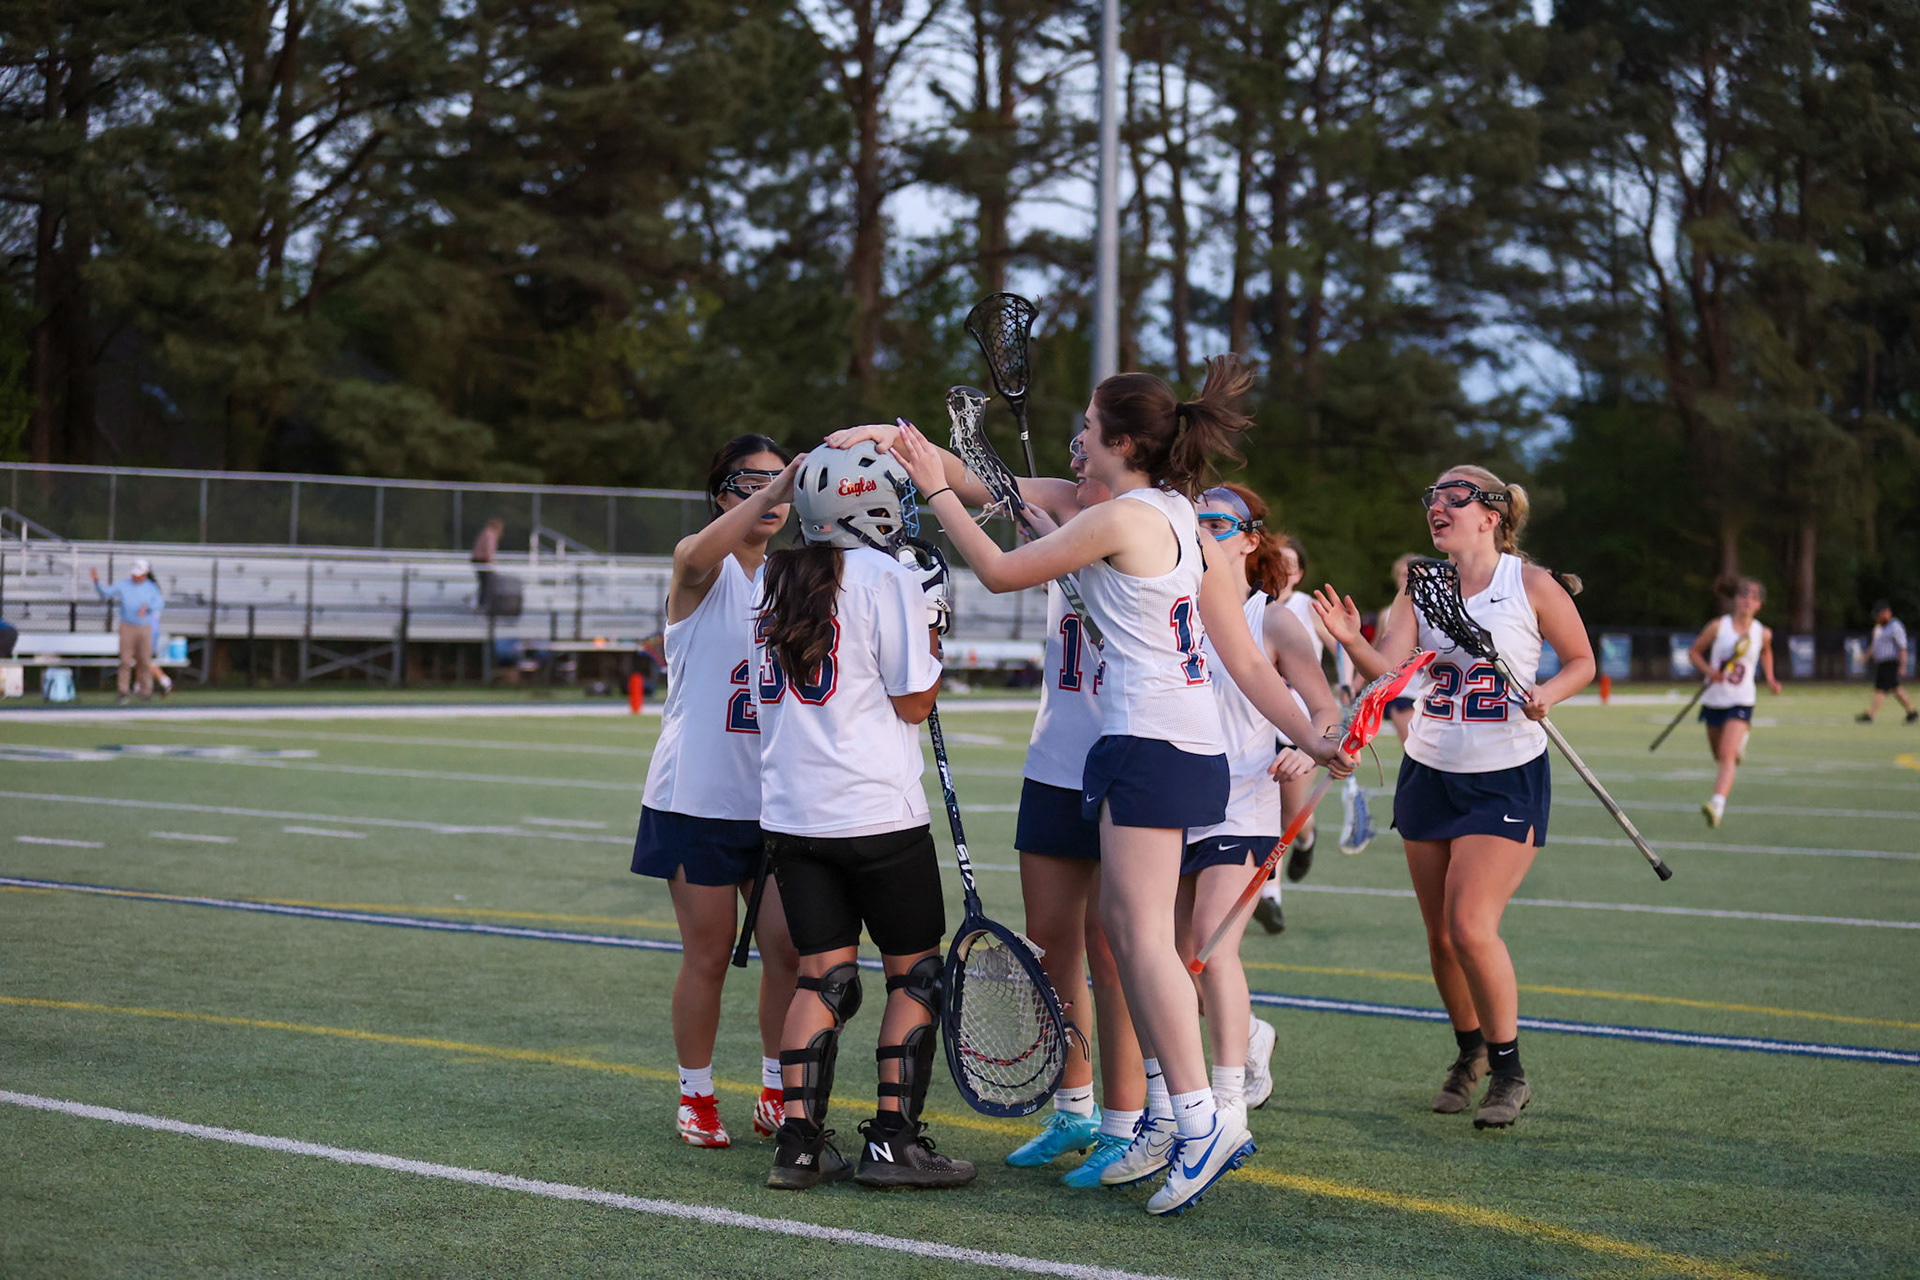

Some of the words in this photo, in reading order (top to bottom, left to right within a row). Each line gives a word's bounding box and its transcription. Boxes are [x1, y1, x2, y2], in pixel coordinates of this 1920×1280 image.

[838, 476, 877, 497] Eagles
[1488, 493, 1504, 501] STX
[1422, 662, 1509, 721] 22
[869, 1141, 895, 1163] N
